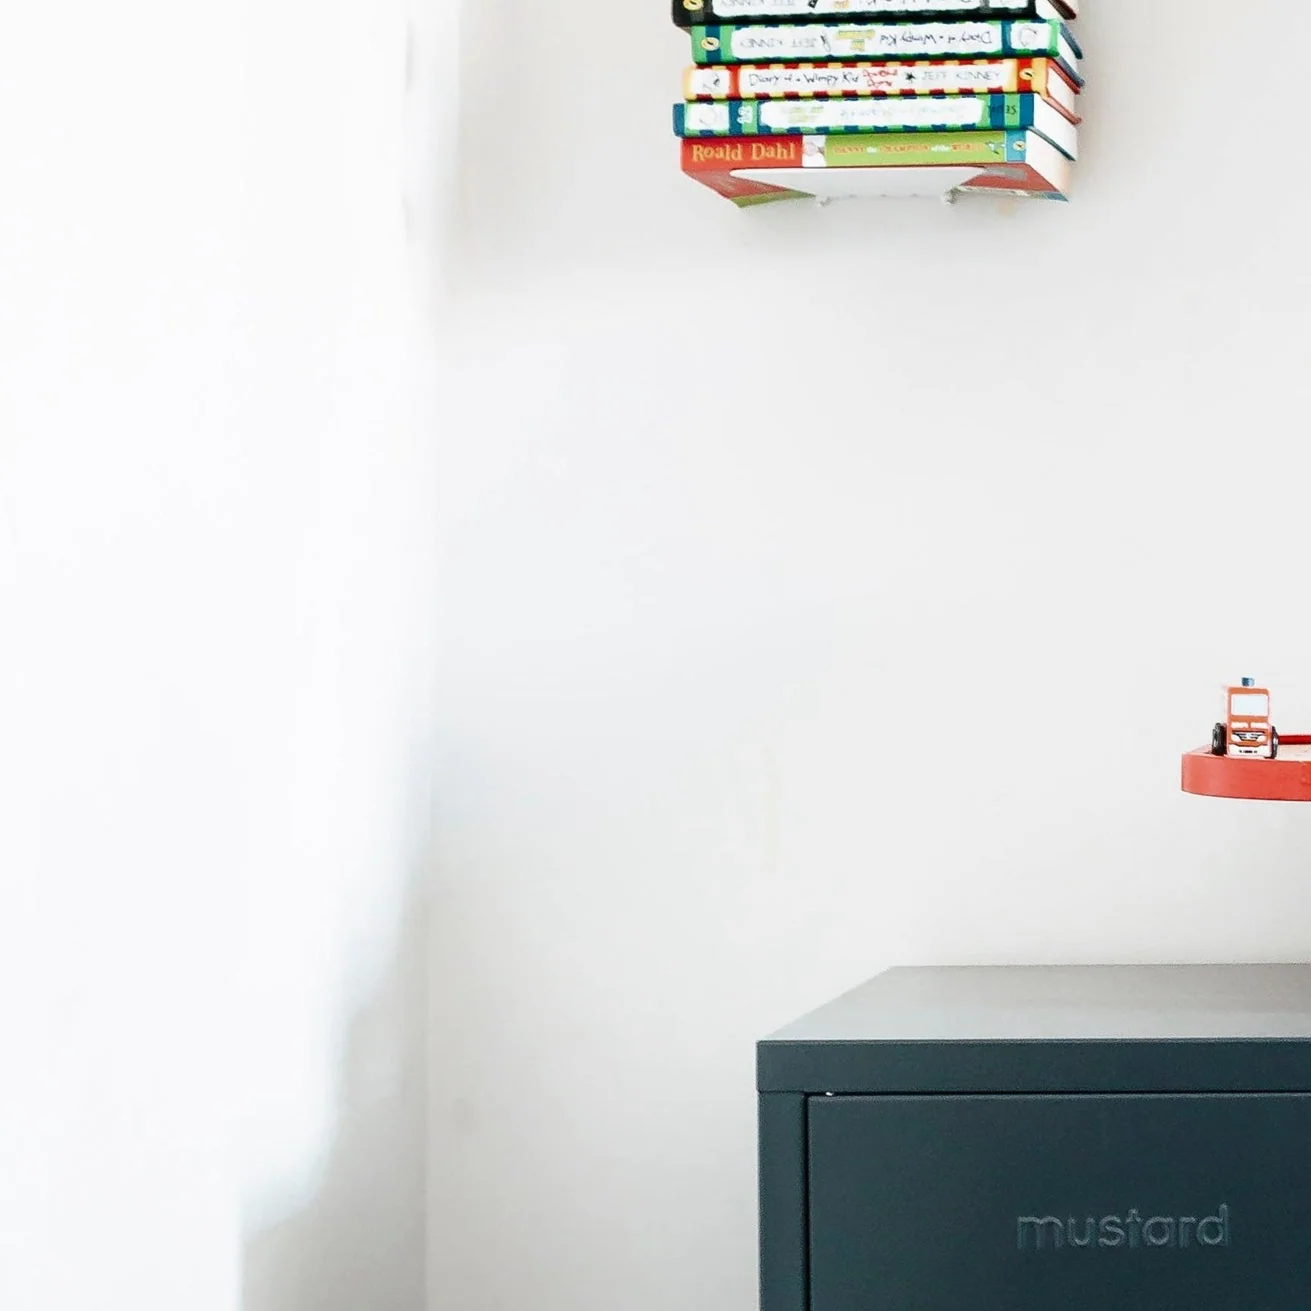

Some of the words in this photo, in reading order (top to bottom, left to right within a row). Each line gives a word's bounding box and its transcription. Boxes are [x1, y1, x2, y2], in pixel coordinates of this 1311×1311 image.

[691, 143, 744, 162] Roald
[750, 142, 797, 161] Dahl
[1016, 1203, 1230, 1250] mustard
